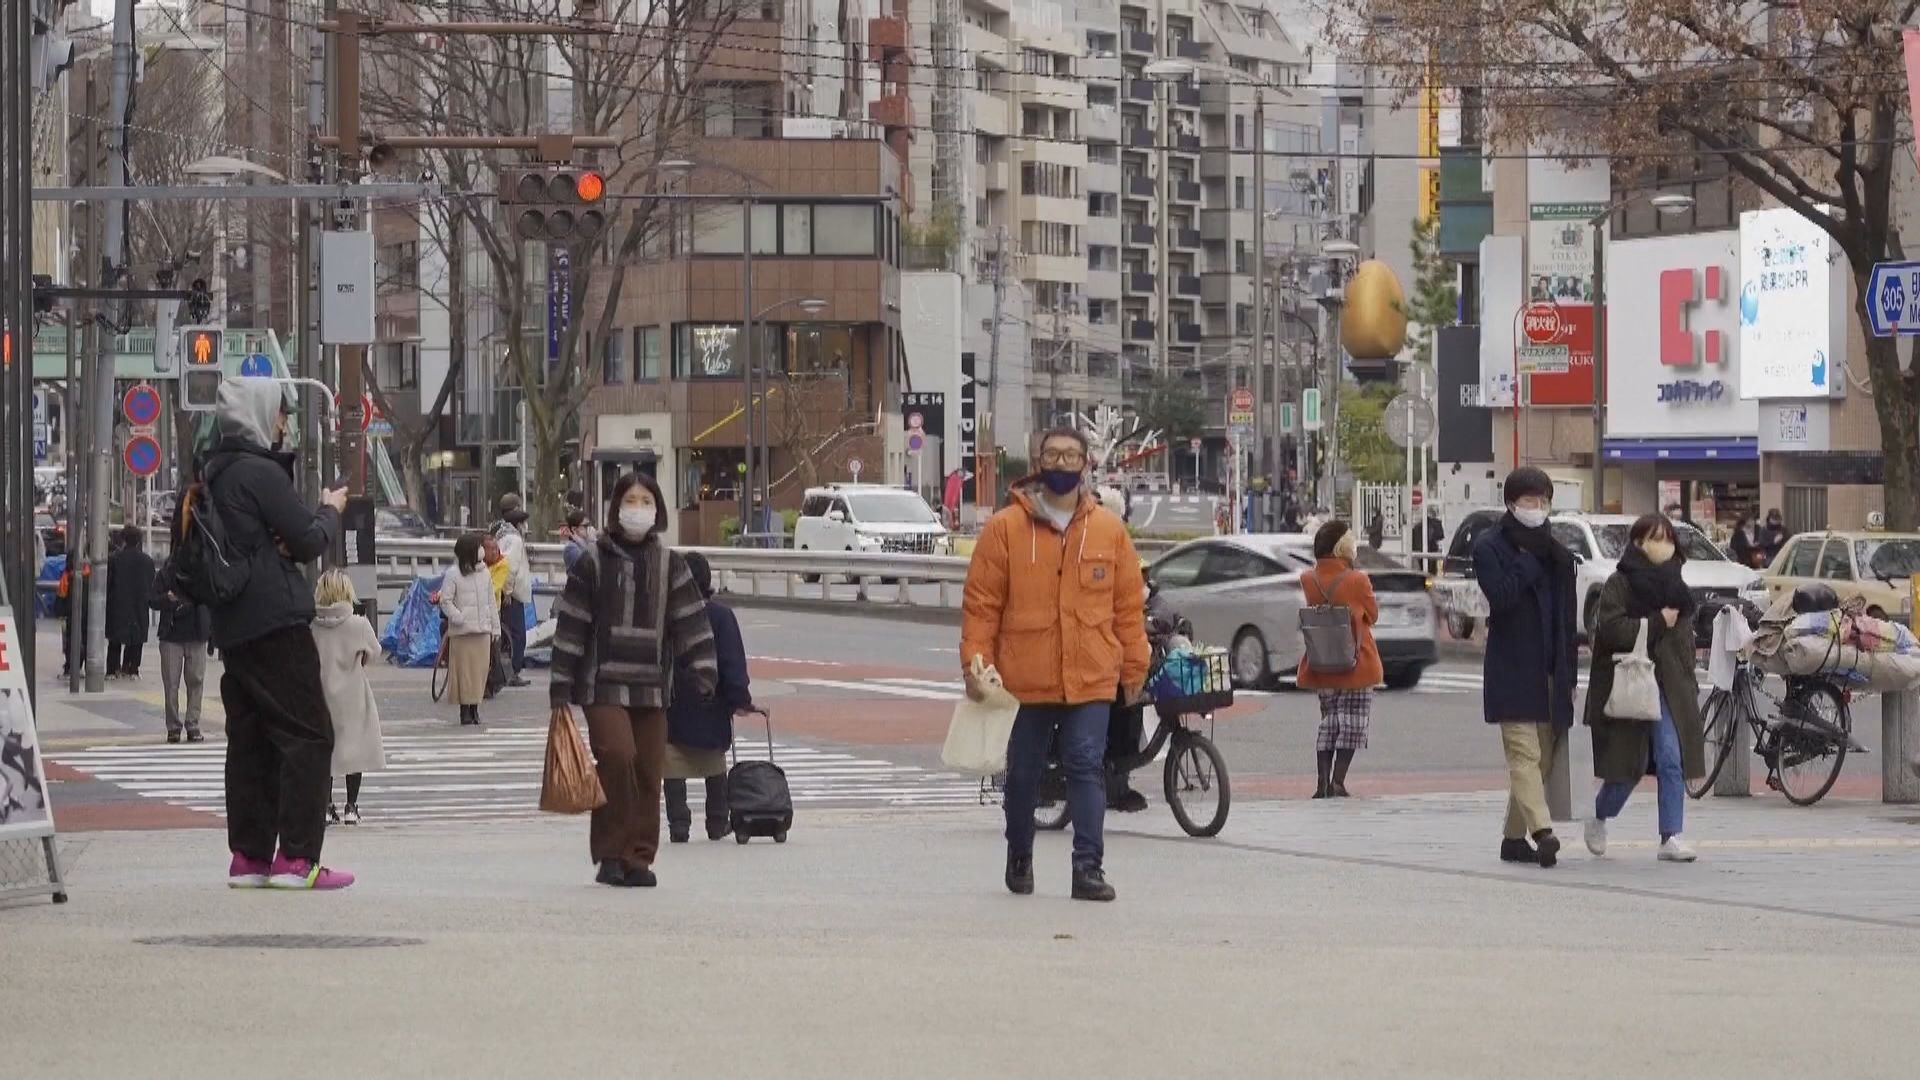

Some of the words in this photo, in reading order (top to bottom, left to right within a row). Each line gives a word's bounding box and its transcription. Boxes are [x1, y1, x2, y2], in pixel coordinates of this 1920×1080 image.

[1883, 286, 1903, 311] 305
[1526, 315, 1556, 331] 消火栓
[1780, 426, 1807, 439] VISION
